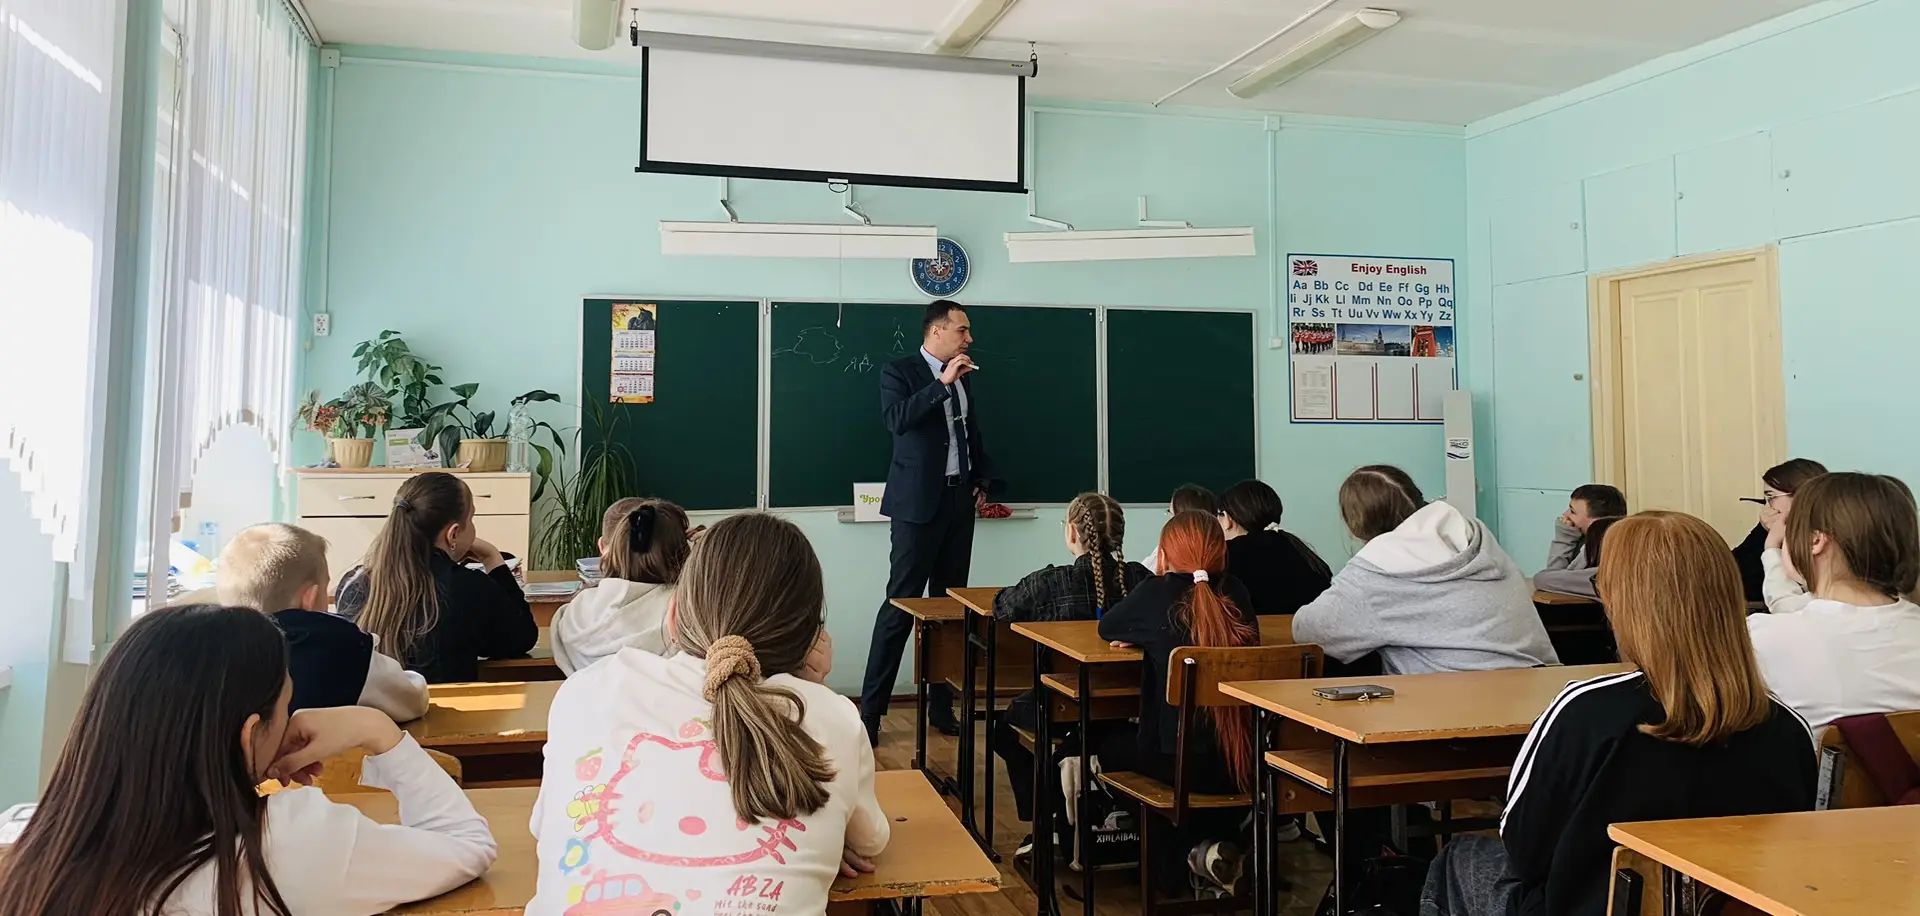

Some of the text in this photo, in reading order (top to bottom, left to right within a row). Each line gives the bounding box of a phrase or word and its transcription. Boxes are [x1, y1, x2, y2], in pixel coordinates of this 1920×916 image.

[1352, 264, 1426, 276] Enjoy English
[1293, 280, 1449, 295] Aa Bb Cc Dd Ee Ff Gg Hh
[1303, 294, 1312, 305] Jj
[1316, 294, 1329, 303] Kk
[1352, 295, 1370, 304] Mm
[1377, 296, 1391, 305] Nn
[1398, 296, 1412, 306] Oo
[1419, 297, 1432, 308] Pp
[1438, 298, 1453, 309] Qq
[1293, 308, 1452, 322] Rr Ss Tt Uu Vv Ww Xx Yy Zz
[860, 494, 881, 504] Уро
